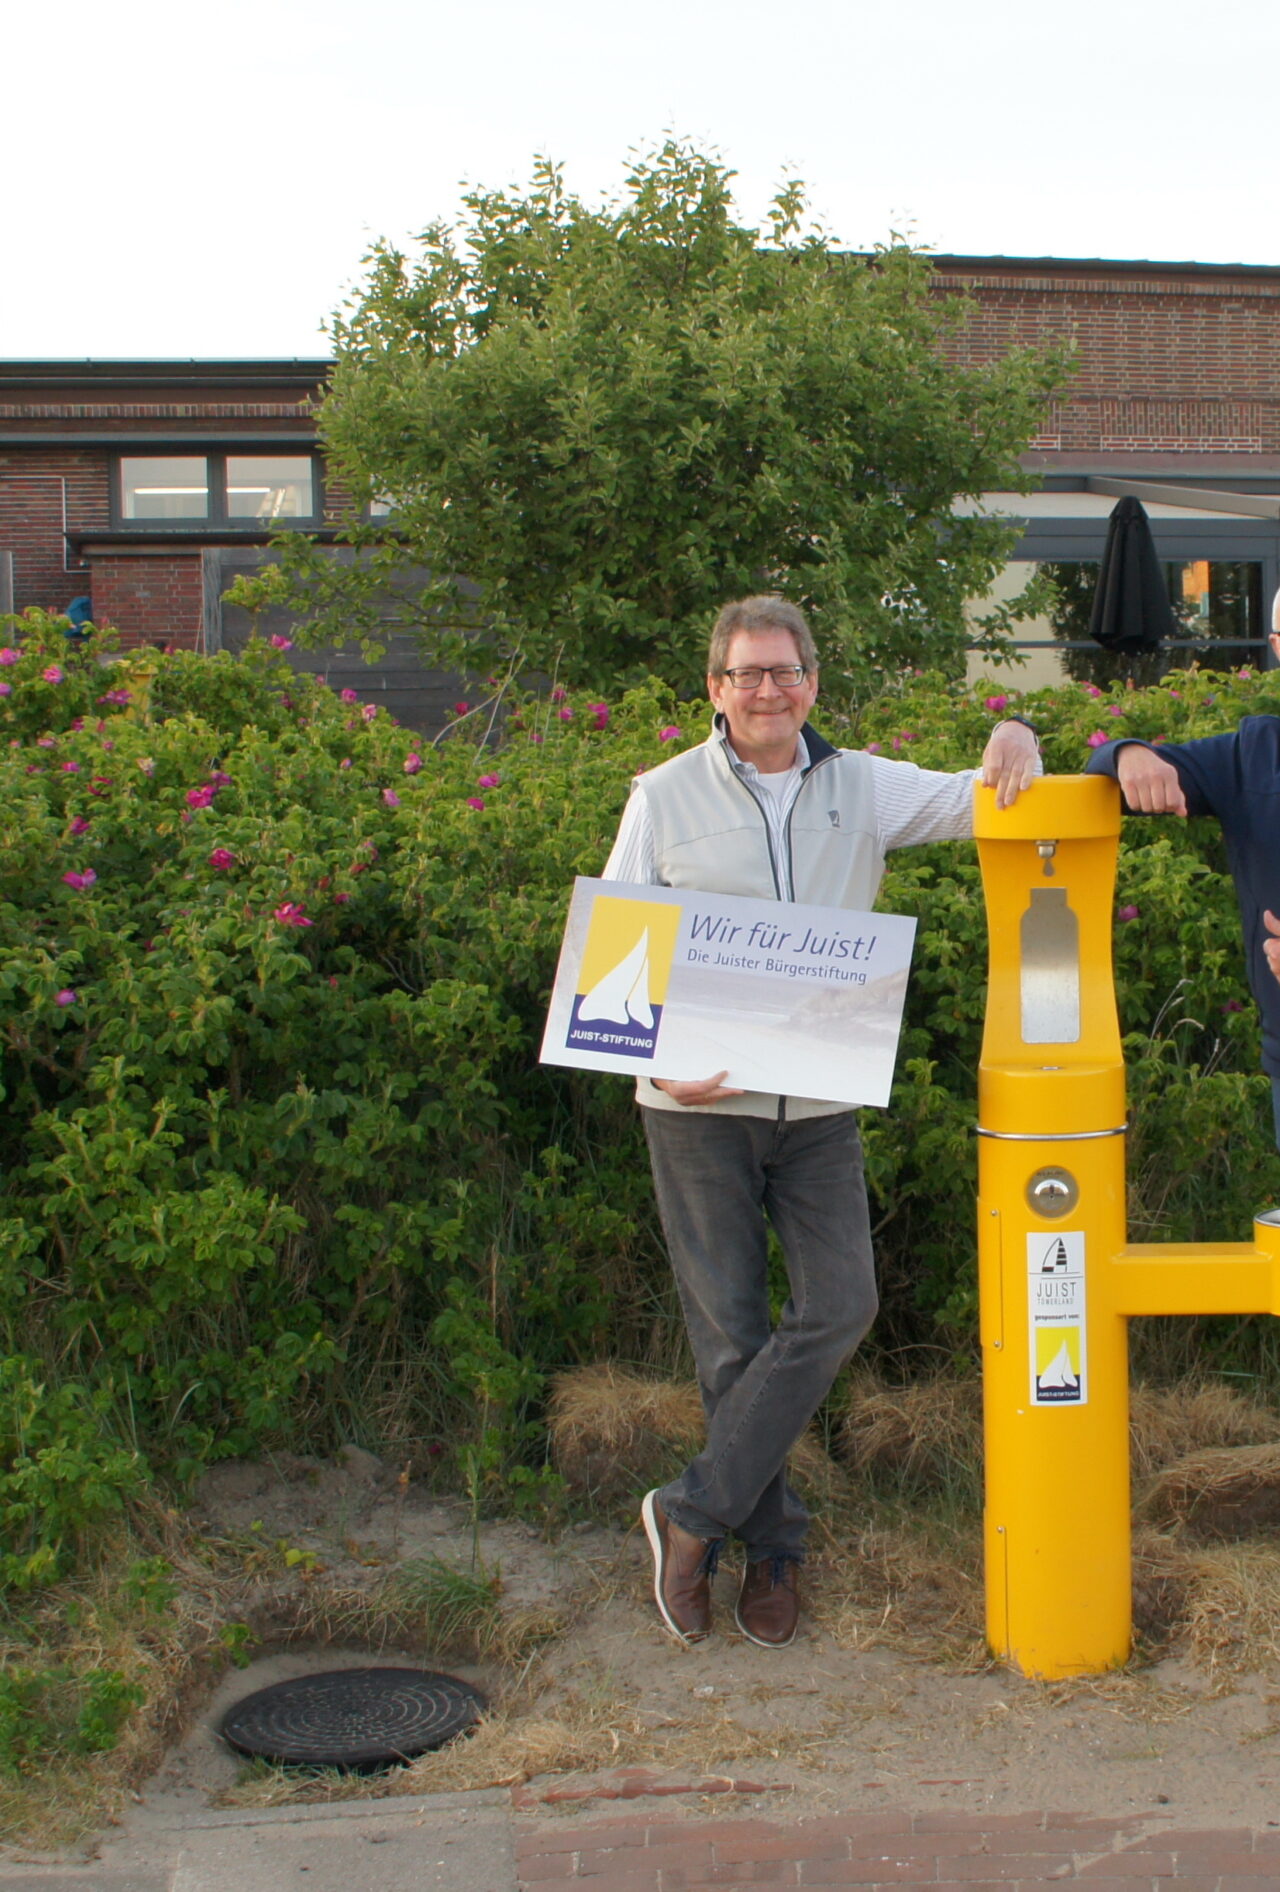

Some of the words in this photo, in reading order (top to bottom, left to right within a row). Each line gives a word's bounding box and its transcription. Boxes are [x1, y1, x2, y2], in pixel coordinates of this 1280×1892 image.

[689, 913, 743, 945] Wir
[746, 921, 792, 951] für
[793, 926, 878, 961] Juist!
[687, 948, 710, 964] Die
[712, 951, 761, 970] Juister
[765, 957, 868, 986] Bürgerstiftung
[570, 1029, 653, 1049] JUIST-STIFTUNG
[1036, 1281, 1076, 1297] JUIST
